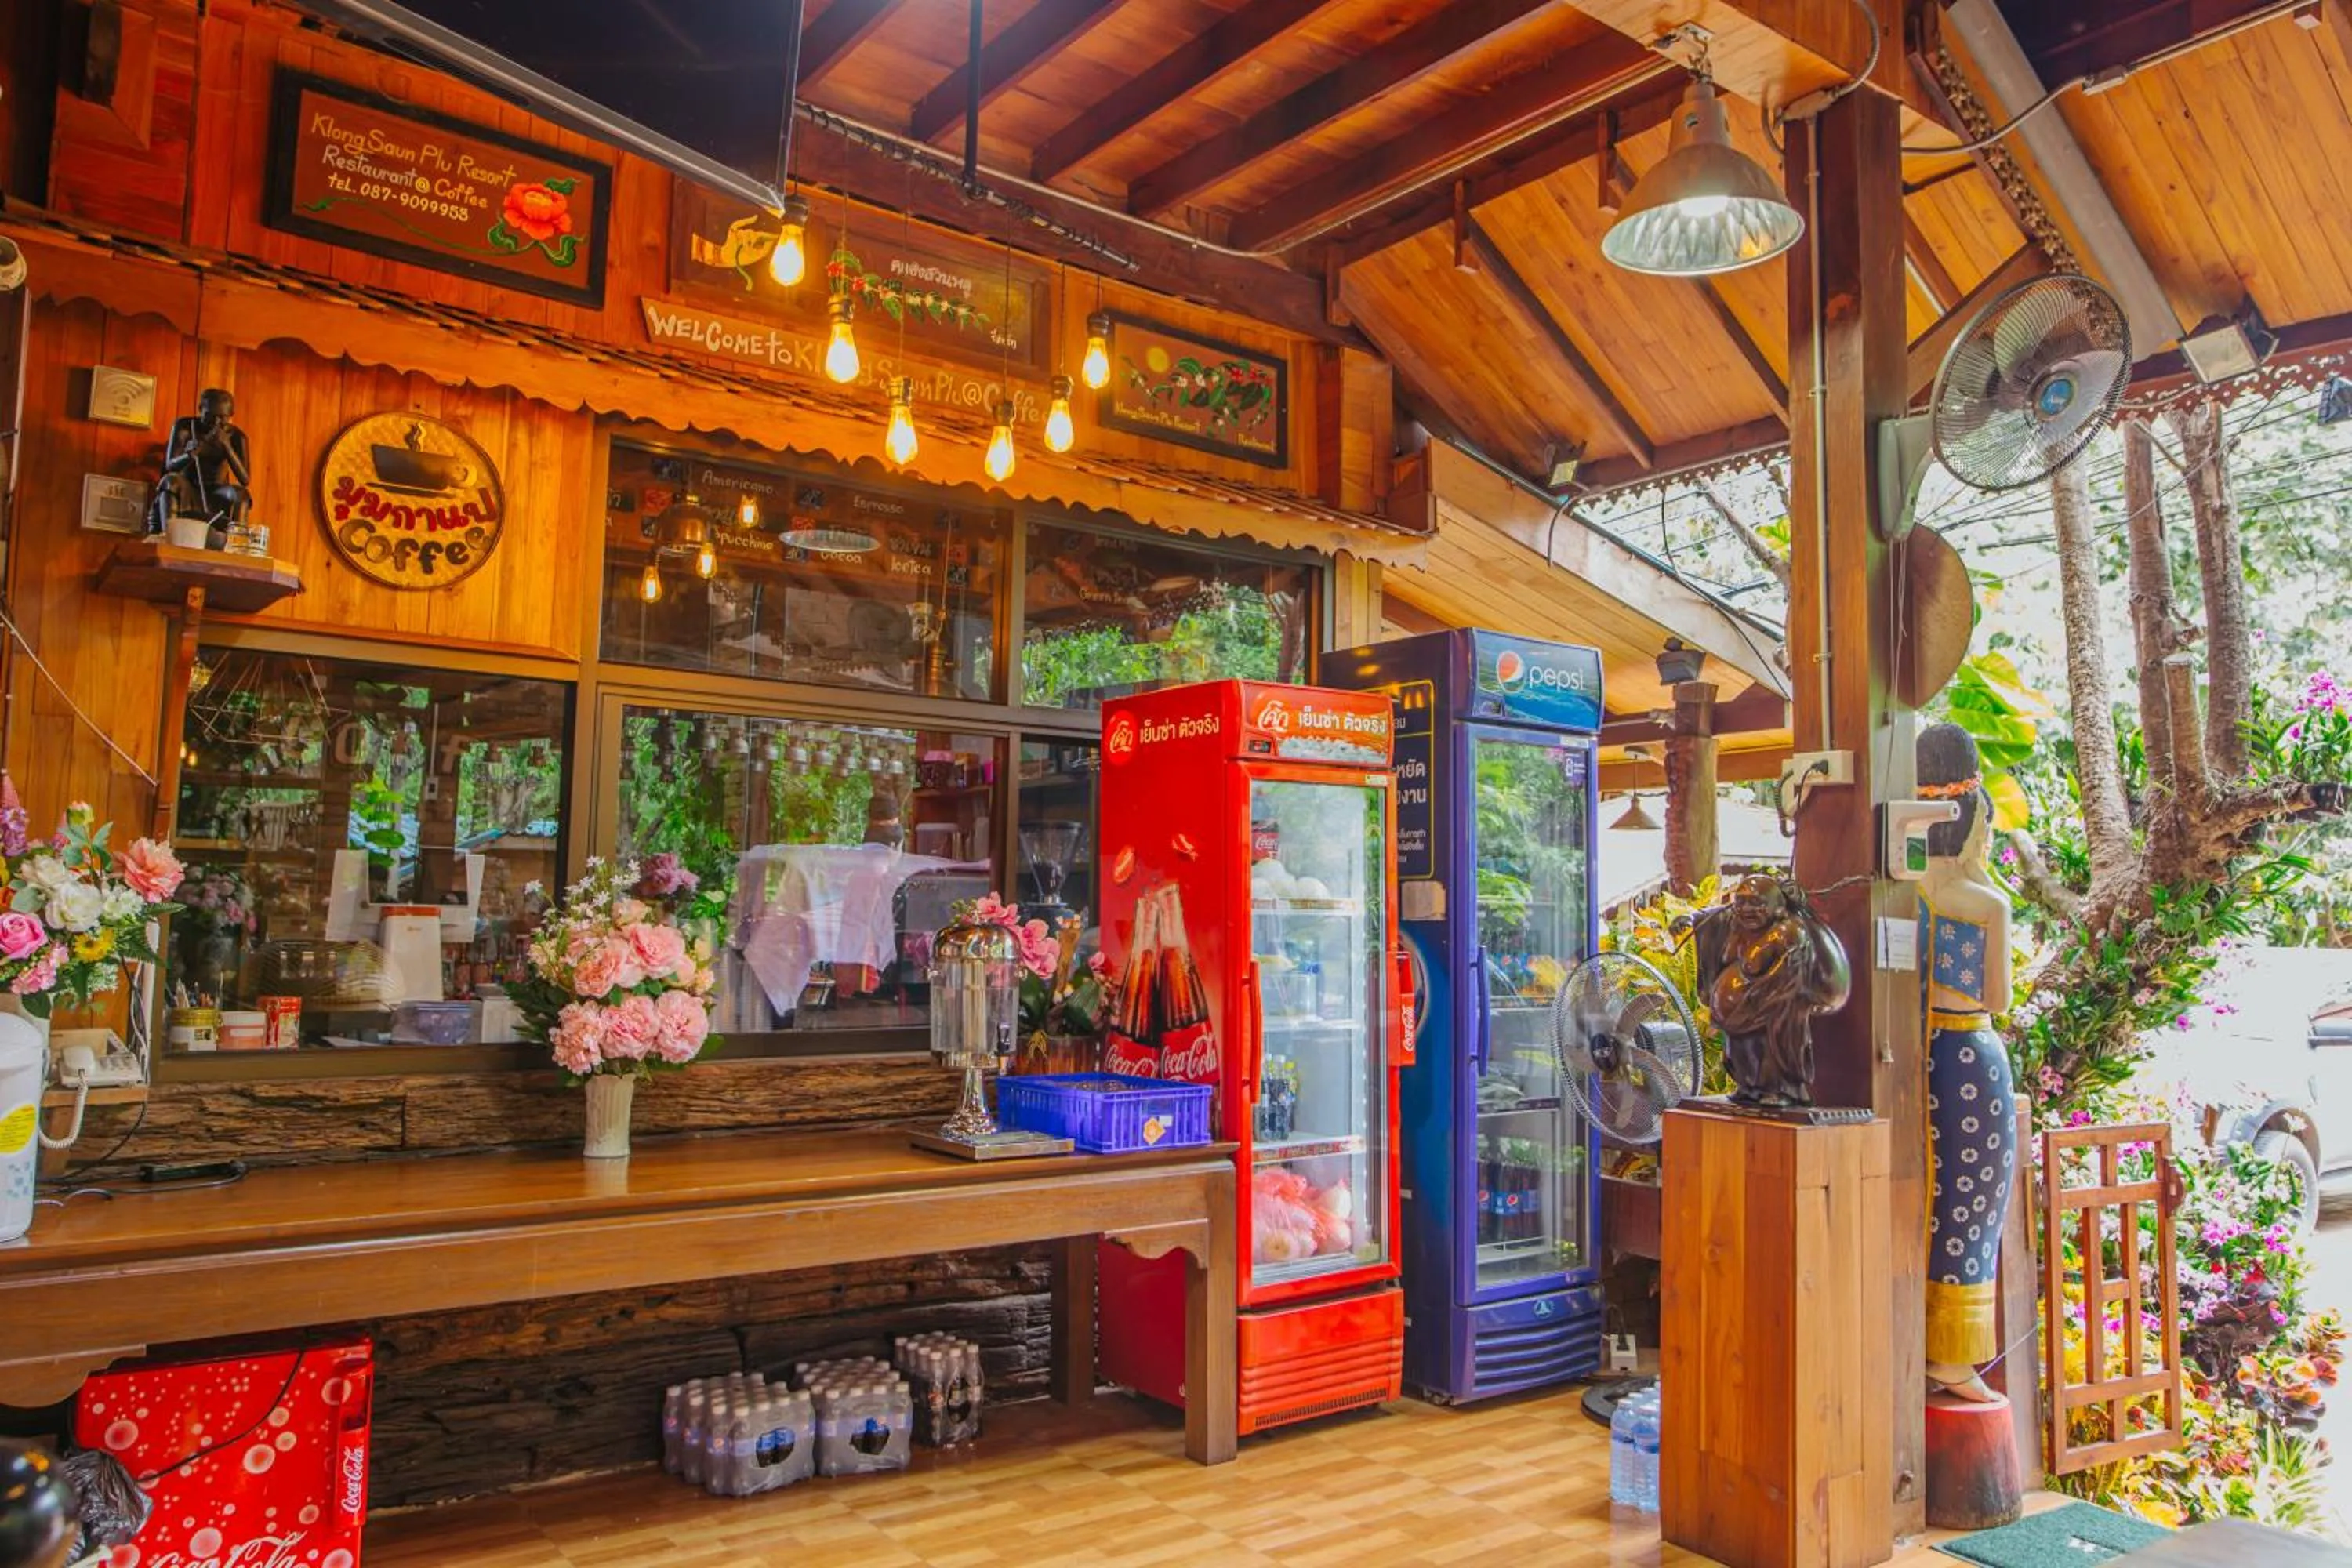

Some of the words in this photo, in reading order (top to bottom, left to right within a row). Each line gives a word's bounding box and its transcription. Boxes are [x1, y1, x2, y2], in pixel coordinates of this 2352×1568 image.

[311, 112, 375, 154] Klong
[367, 129, 416, 162] Saun
[419, 144, 452, 172] Plu
[457, 154, 517, 188] Resort
[322, 144, 419, 187] Restaurant
[702, 469, 774, 495] Americano
[339, 518, 492, 574] Coffee
[1530, 665, 1585, 693] pepsi
[342, 1446, 364, 1514] Coca-Cola
